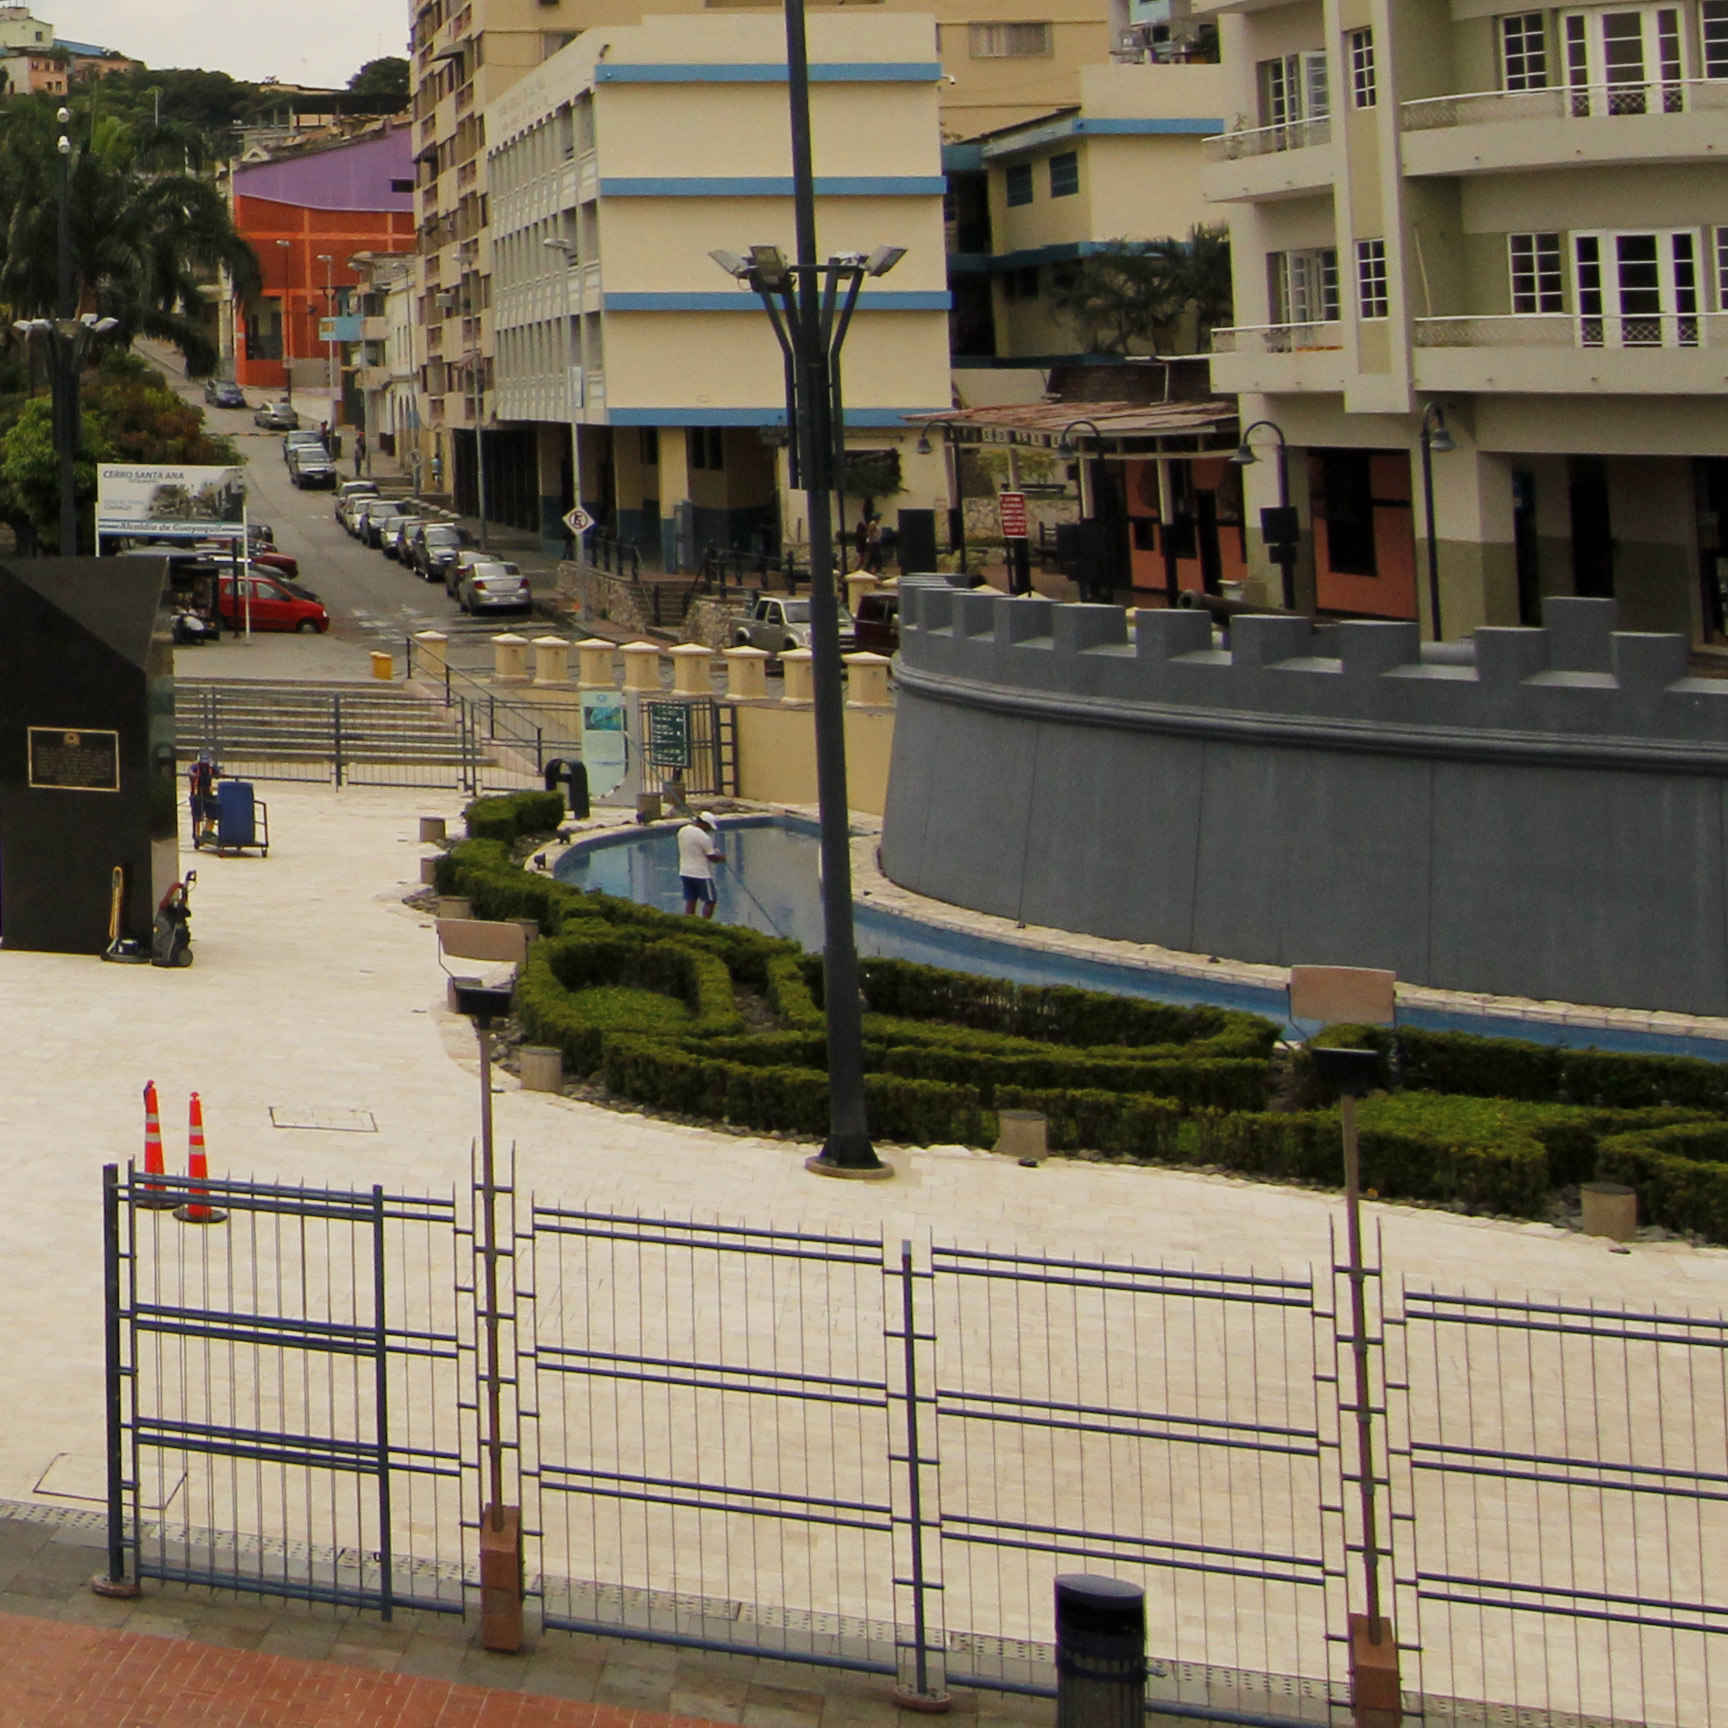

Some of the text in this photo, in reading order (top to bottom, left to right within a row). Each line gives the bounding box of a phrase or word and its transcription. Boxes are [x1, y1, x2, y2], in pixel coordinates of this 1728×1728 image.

[103, 470, 184, 480] CERRO SANTA ANA
